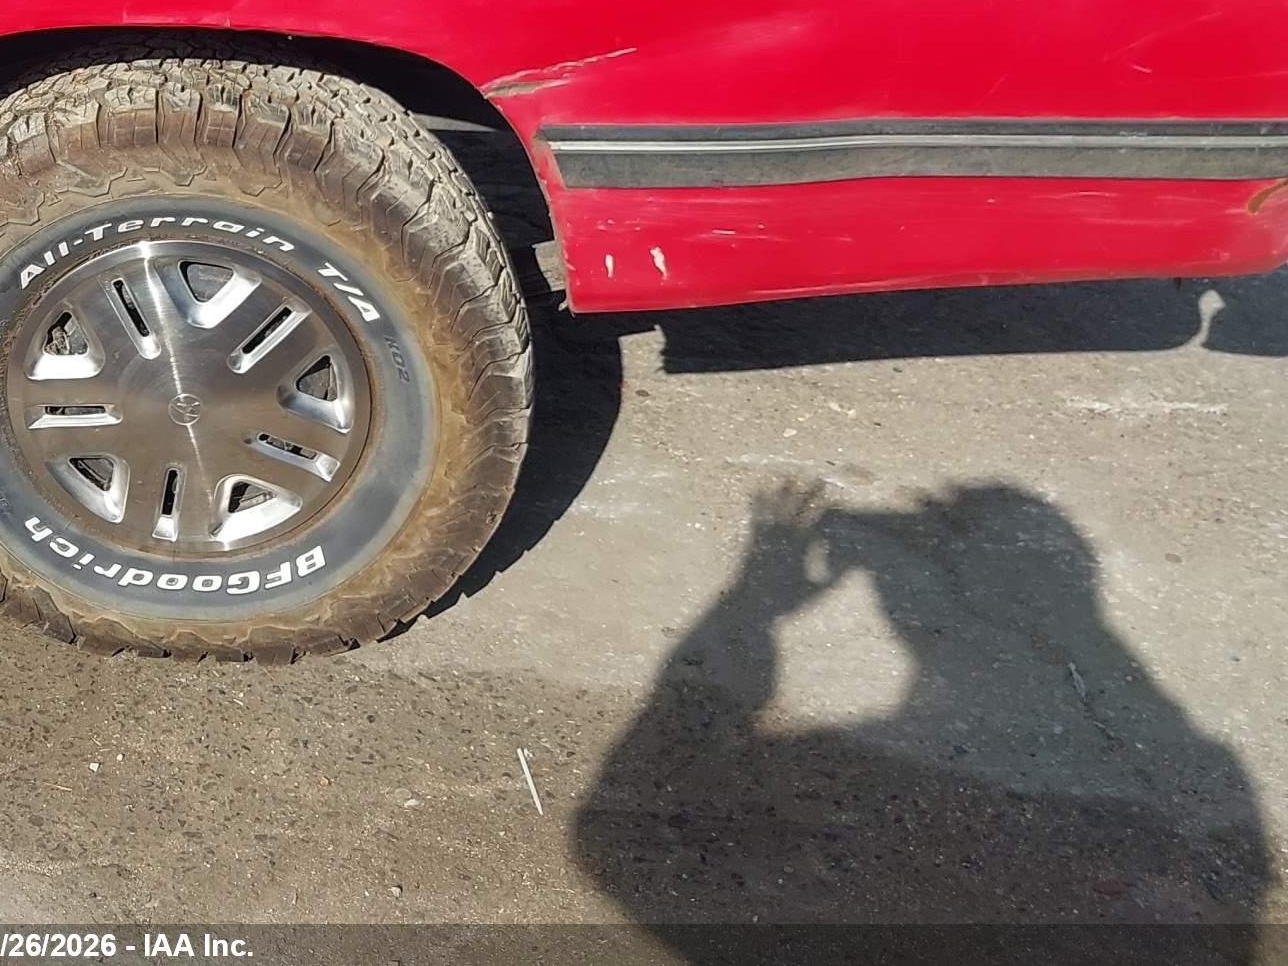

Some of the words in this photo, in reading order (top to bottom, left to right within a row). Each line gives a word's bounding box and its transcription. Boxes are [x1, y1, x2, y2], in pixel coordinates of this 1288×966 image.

[19, 215, 295, 290] All-Terrain
[317, 262, 382, 323] T/A
[24, 516, 327, 595] BFGoodrich
